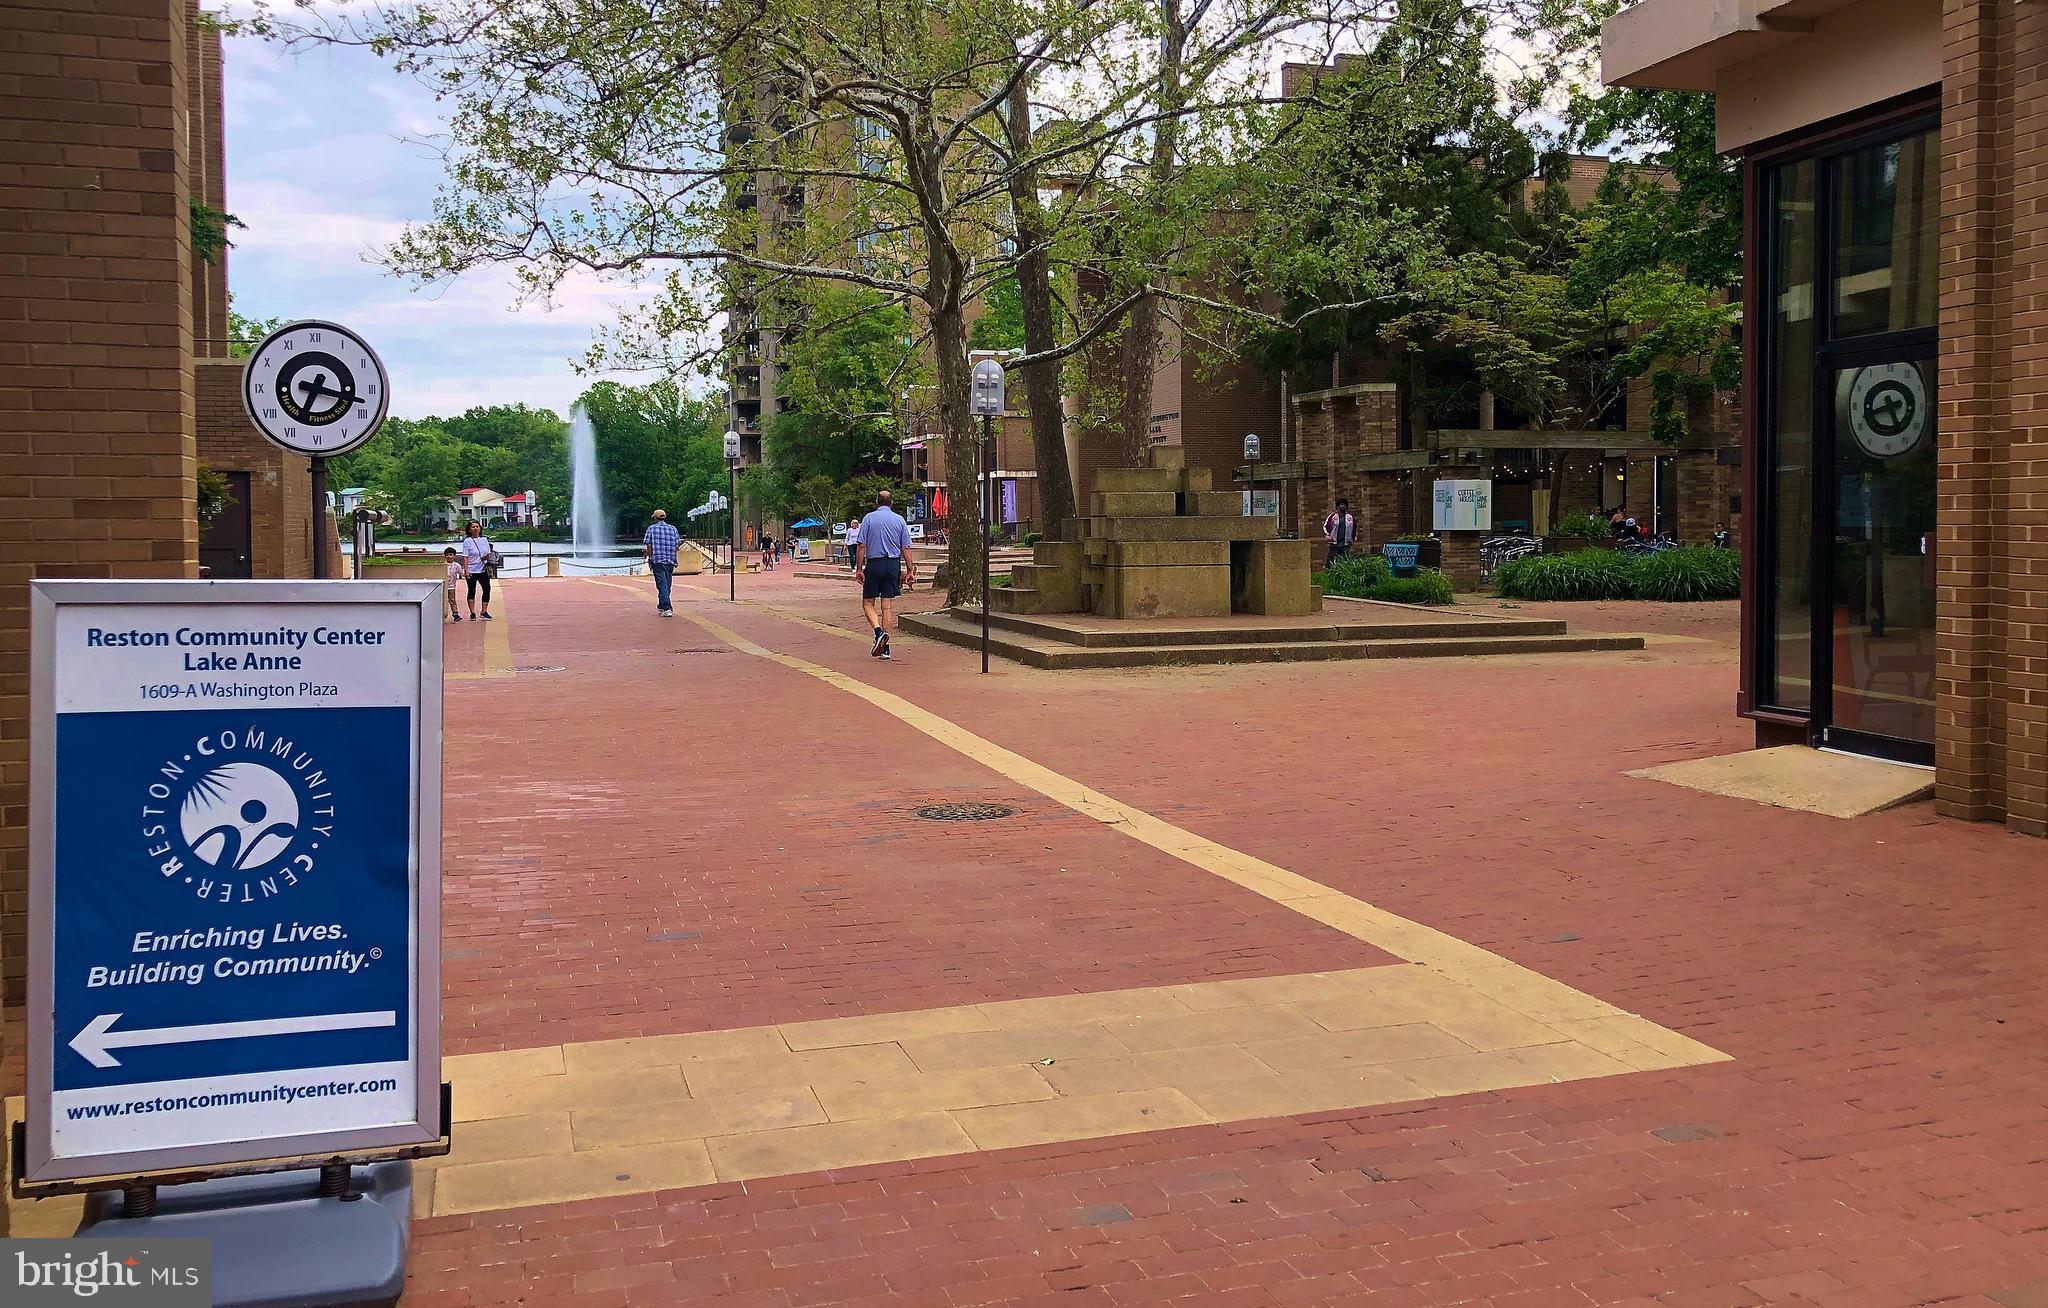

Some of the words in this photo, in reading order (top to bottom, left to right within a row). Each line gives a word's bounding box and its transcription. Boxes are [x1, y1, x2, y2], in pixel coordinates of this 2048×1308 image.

[309, 332, 321, 343] XII
[283, 339, 293, 350] XI
[264, 357, 271, 368] X
[360, 358, 366, 369] II
[254, 383, 265, 394] IX
[368, 384, 376, 395] III
[281, 394, 300, 417] Health
[262, 408, 277, 419] VIII
[357, 409, 368, 420] IIII
[284, 427, 296, 438] VII
[341, 428, 348, 439] V
[312, 435, 322, 446] VI
[1457, 489, 1475, 497] COFFEE
[87, 628, 169, 647] Reston
[176, 627, 307, 650] Community
[313, 626, 386, 646] Center
[183, 653, 238, 671] Lake
[243, 652, 302, 671] Anne
[139, 683, 198, 699] 1609-A
[201, 682, 295, 699] Washington
[298, 681, 339, 697] Plaza
[196, 730, 335, 838] COMMUNITY
[142, 760, 185, 878] RESTON
[196, 853, 314, 903] CENTER
[132, 926, 264, 952] Enriching
[272, 921, 349, 943] Lives.
[87, 957, 205, 988] Building
[67, 1078, 397, 1119] www.restoncommunitycenter.com
